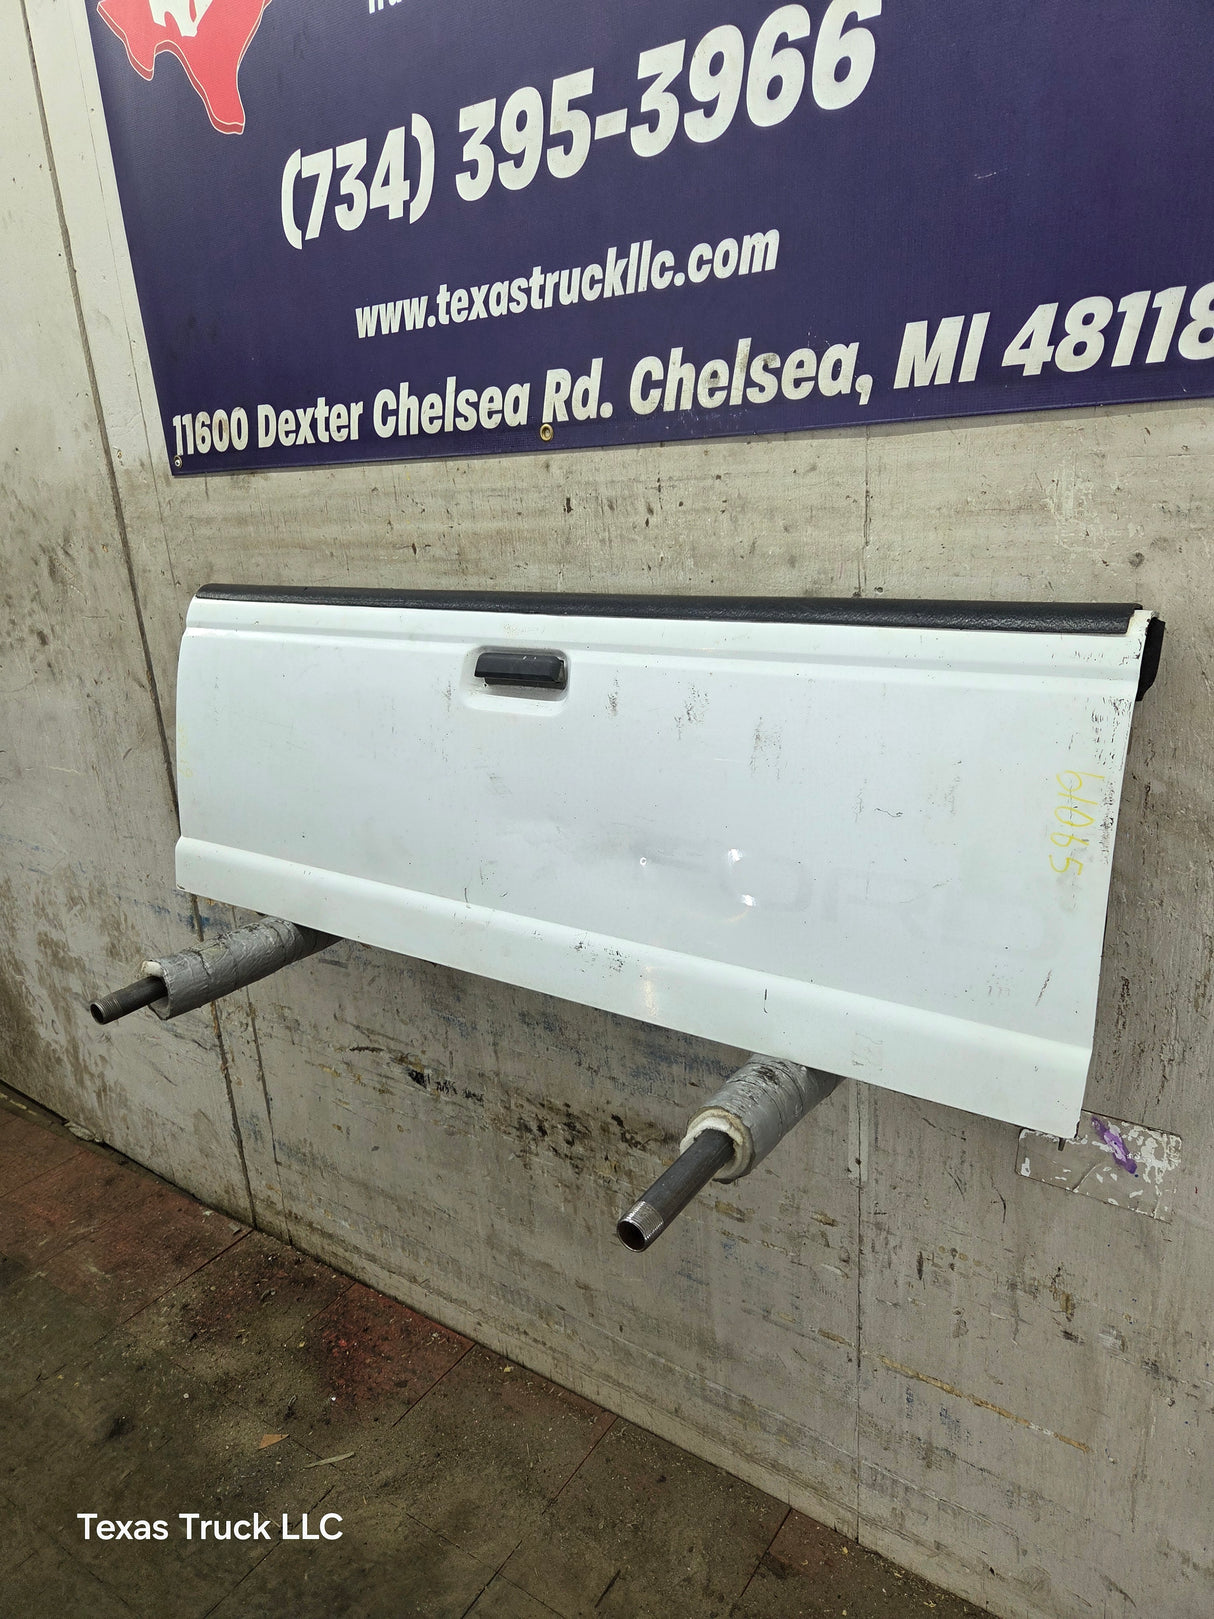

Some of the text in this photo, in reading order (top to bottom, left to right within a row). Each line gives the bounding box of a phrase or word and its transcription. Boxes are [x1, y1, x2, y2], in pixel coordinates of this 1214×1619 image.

[281, 0, 882, 249] (734) 395-3966
[173, 281, 1214, 455] 11600 Dexter Chelsea Rd. Chelsea, MI 48118
[355, 229, 780, 338] www.texastruckllc.com
